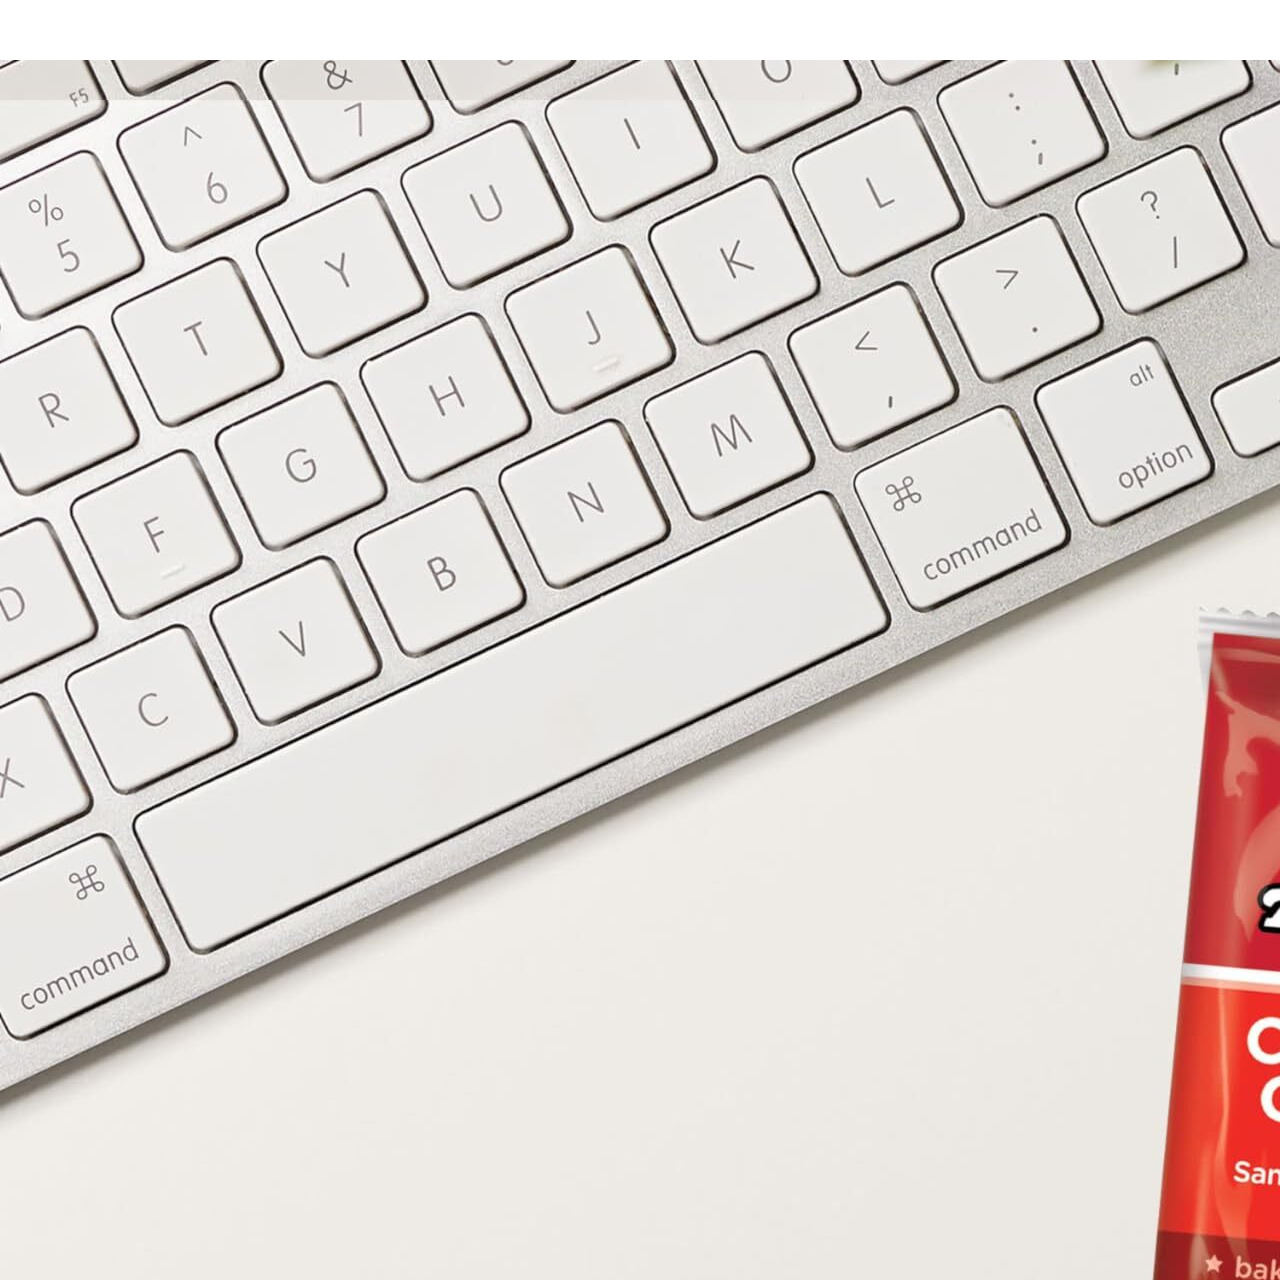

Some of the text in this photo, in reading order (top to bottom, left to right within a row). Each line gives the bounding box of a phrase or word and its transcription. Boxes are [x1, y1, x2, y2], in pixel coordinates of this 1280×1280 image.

[322, 59, 354, 91] &
[68, 86, 90, 107] F5
[343, 101, 363, 138] 7
[206, 171, 229, 205] 6
[468, 184, 503, 223] U
[865, 176, 896, 209] L
[1140, 190, 1162, 220] ?
[27, 193, 65, 228] %
[56, 238, 81, 273] 5
[323, 251, 351, 289] Y
[719, 239, 756, 280] K
[182, 320, 209, 357] T
[585, 309, 603, 346] J
[1128, 362, 1156, 388] alt
[37, 392, 70, 429] R
[428, 375, 466, 417] H
[710, 413, 753, 458] M
[284, 447, 318, 484] G
[1117, 442, 1195, 492] option
[566, 481, 606, 523] N
[143, 515, 166, 554] F
[922, 506, 1044, 582] command
[426, 555, 457, 593] B
[0, 586, 26, 622] D
[278, 620, 307, 658] V
[137, 692, 169, 728] C
[0, 757, 25, 799] X
[19, 936, 141, 1012] command
